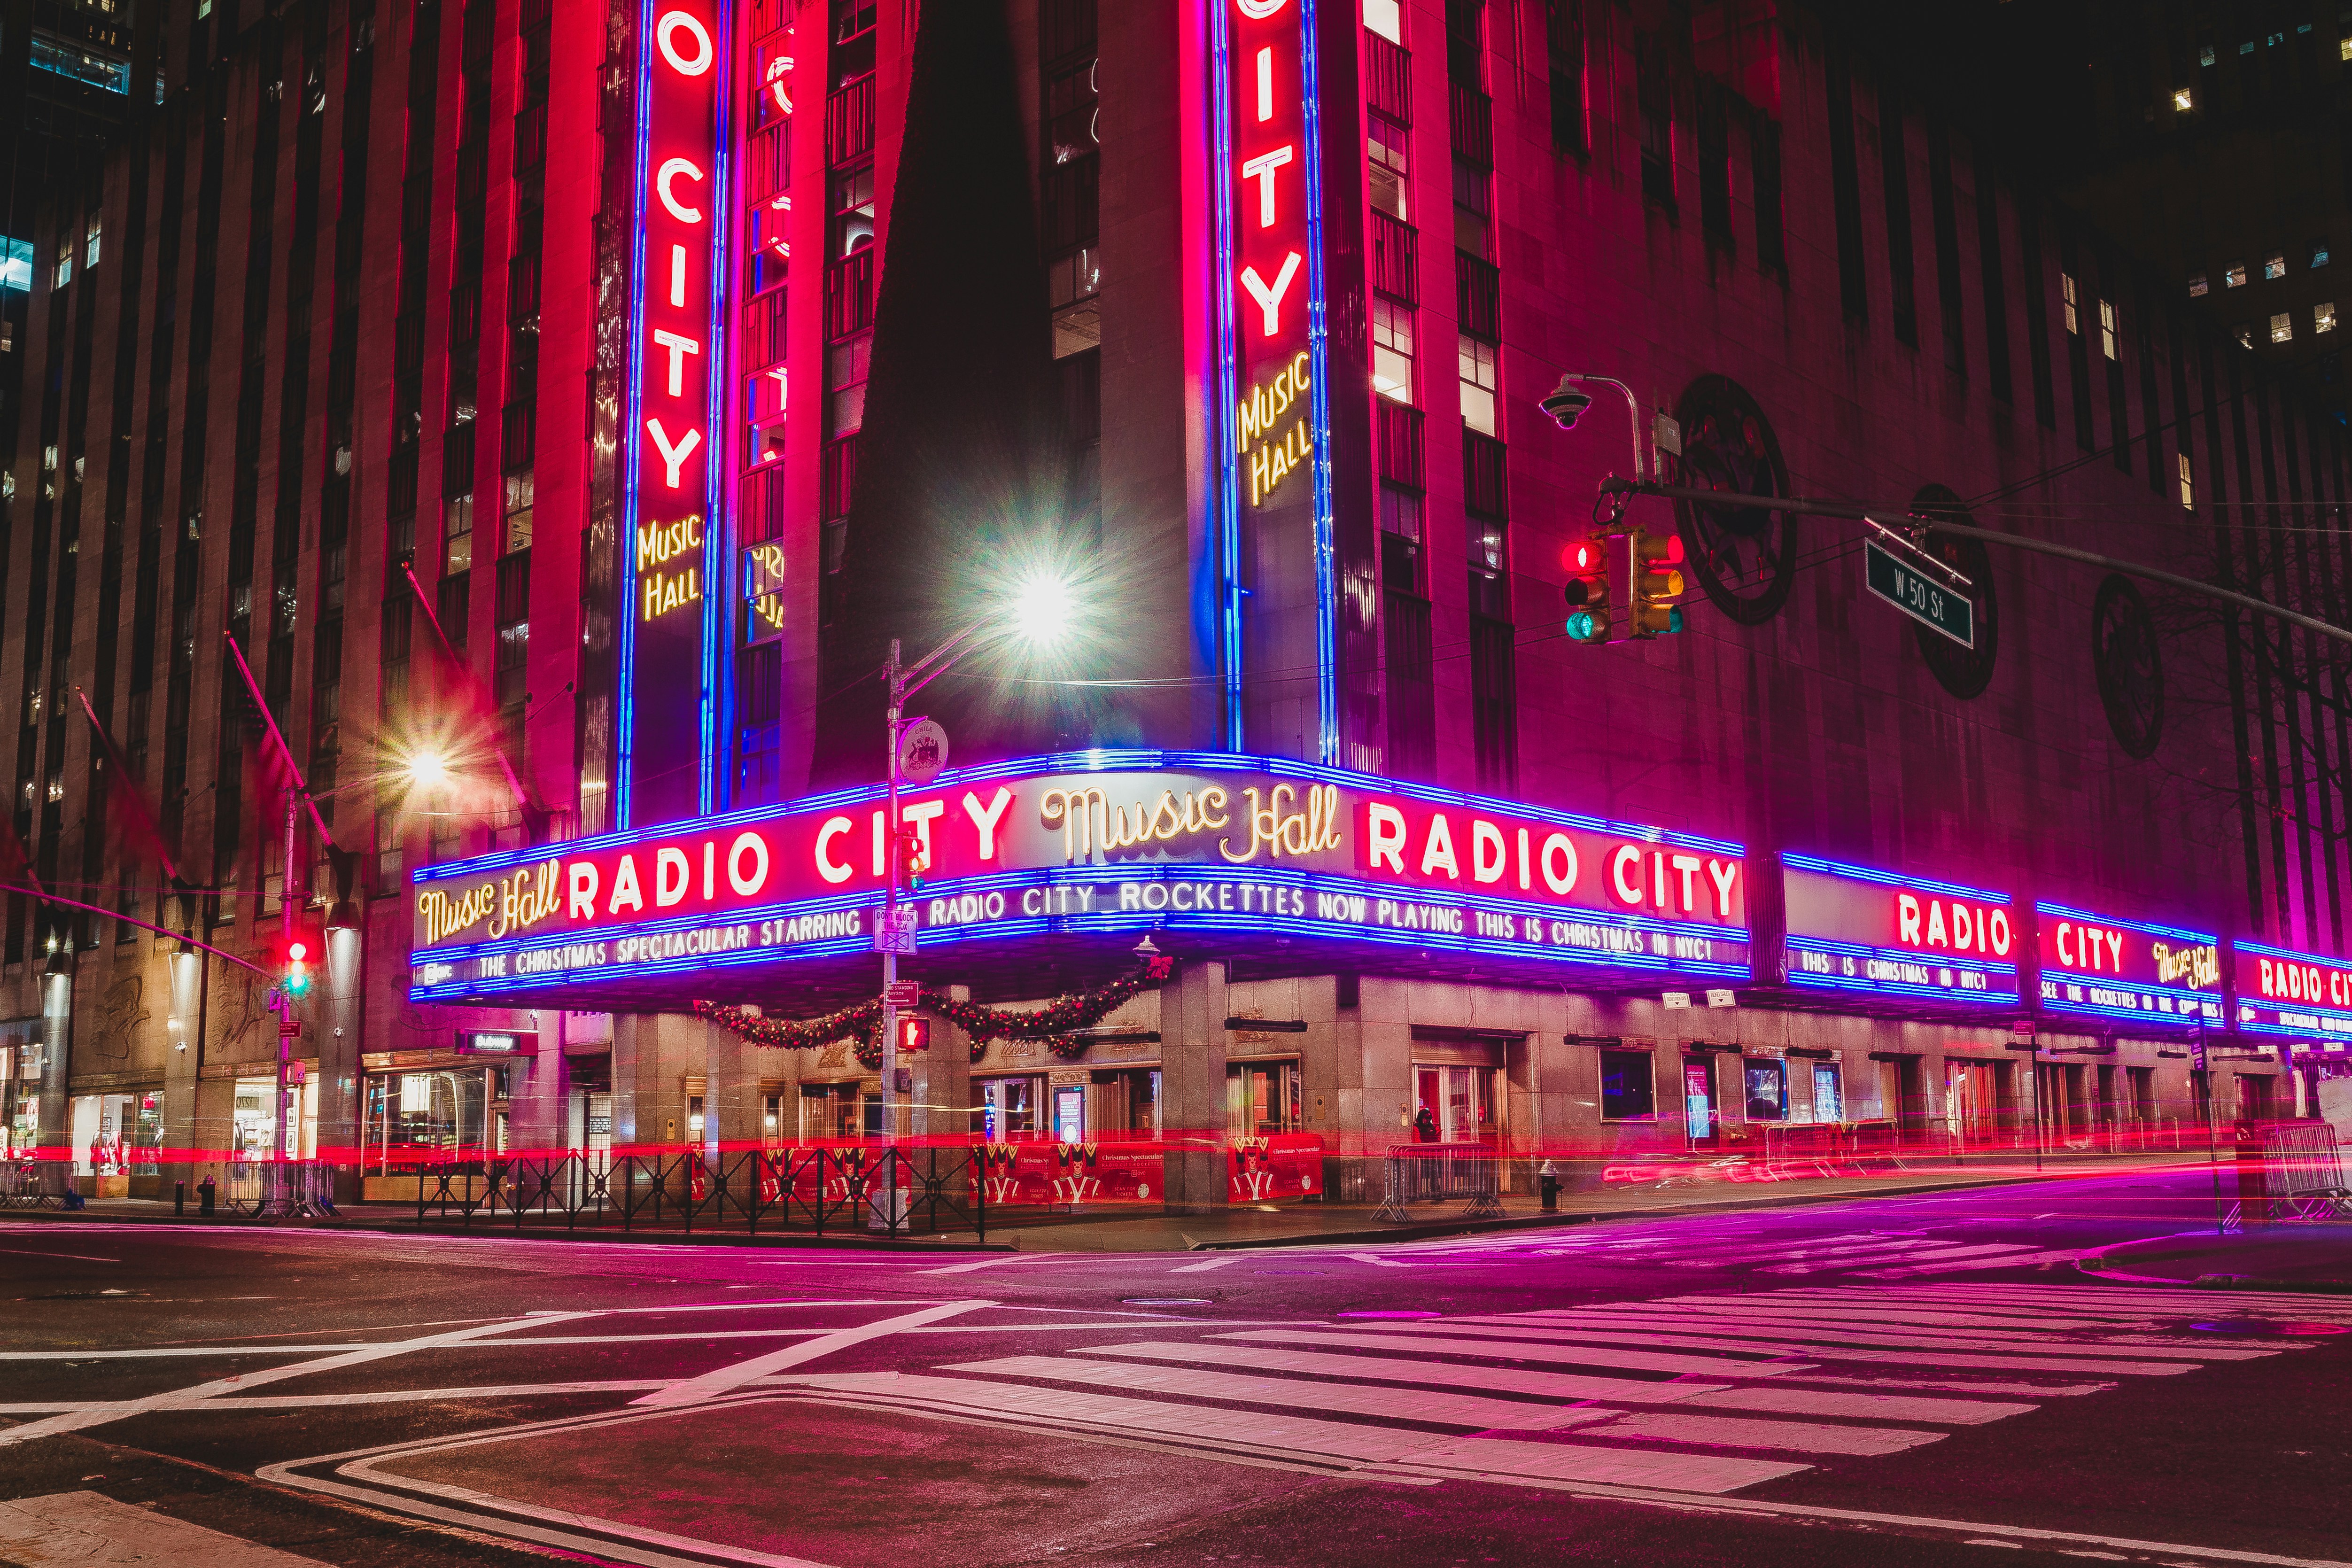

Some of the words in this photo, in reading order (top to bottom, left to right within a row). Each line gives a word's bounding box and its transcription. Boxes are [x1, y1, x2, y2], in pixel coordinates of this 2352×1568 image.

[646, 158, 704, 489] CITY
[1237, 352, 1310, 453] MUSIC
[1252, 417, 1311, 506] HALL
[637, 514, 701, 573] MUSIC
[644, 567, 700, 622] HALL
[1895, 568, 1904, 598] W
[1910, 578, 1925, 610] 50
[1931, 591, 1944, 621] St
[915, 726, 933, 735] CHILE
[1040, 786, 1230, 860] Music
[1219, 783, 1342, 863] Hall
[569, 831, 769, 920] RADIO
[815, 786, 1012, 883] CITY
[1369, 801, 1578, 895] RADIO
[1613, 845, 1736, 916] CITY
[419, 883, 495, 946] Music
[488, 858, 562, 939] Hall
[480, 955, 506, 978] THE
[516, 942, 606, 974] CHRISTMAS
[617, 924, 749, 963] SPECTACULAR
[761, 910, 860, 946] STARRING
[930, 891, 1005, 927] RADIO
[1023, 886, 1094, 916] CITY
[1121, 883, 1304, 916] ROCKETTES
[1318, 893, 1366, 924] NOW
[1378, 899, 1463, 932] PLAYING
[1475, 911, 1514, 939] THIS
[1526, 918, 1542, 942] IS
[1552, 922, 1643, 954] CHRISTMAS
[1653, 934, 1668, 955] IN
[1676, 937, 1712, 960] NYC!
[895, 913, 914, 922] BLOCK
[1899, 893, 2010, 956] RADIO
[1801, 951, 1830, 974] THIS
[1843, 956, 1855, 977] IS
[1867, 959, 1929, 985] CHRISTMAS
[1961, 970, 1987, 990] NYC!
[2057, 922, 2122, 972] CITY
[2153, 942, 2192, 984] Music
[2188, 945, 2220, 990] Hall
[2041, 980, 2058, 999] SEE
[2067, 984, 2083, 1002] THE
[2090, 988, 2137, 1009] ROCKETTES
[2158, 996, 2173, 1013] THE
[2260, 959, 2321, 1003] RADIO
[476, 1035, 512, 1049] Subway
